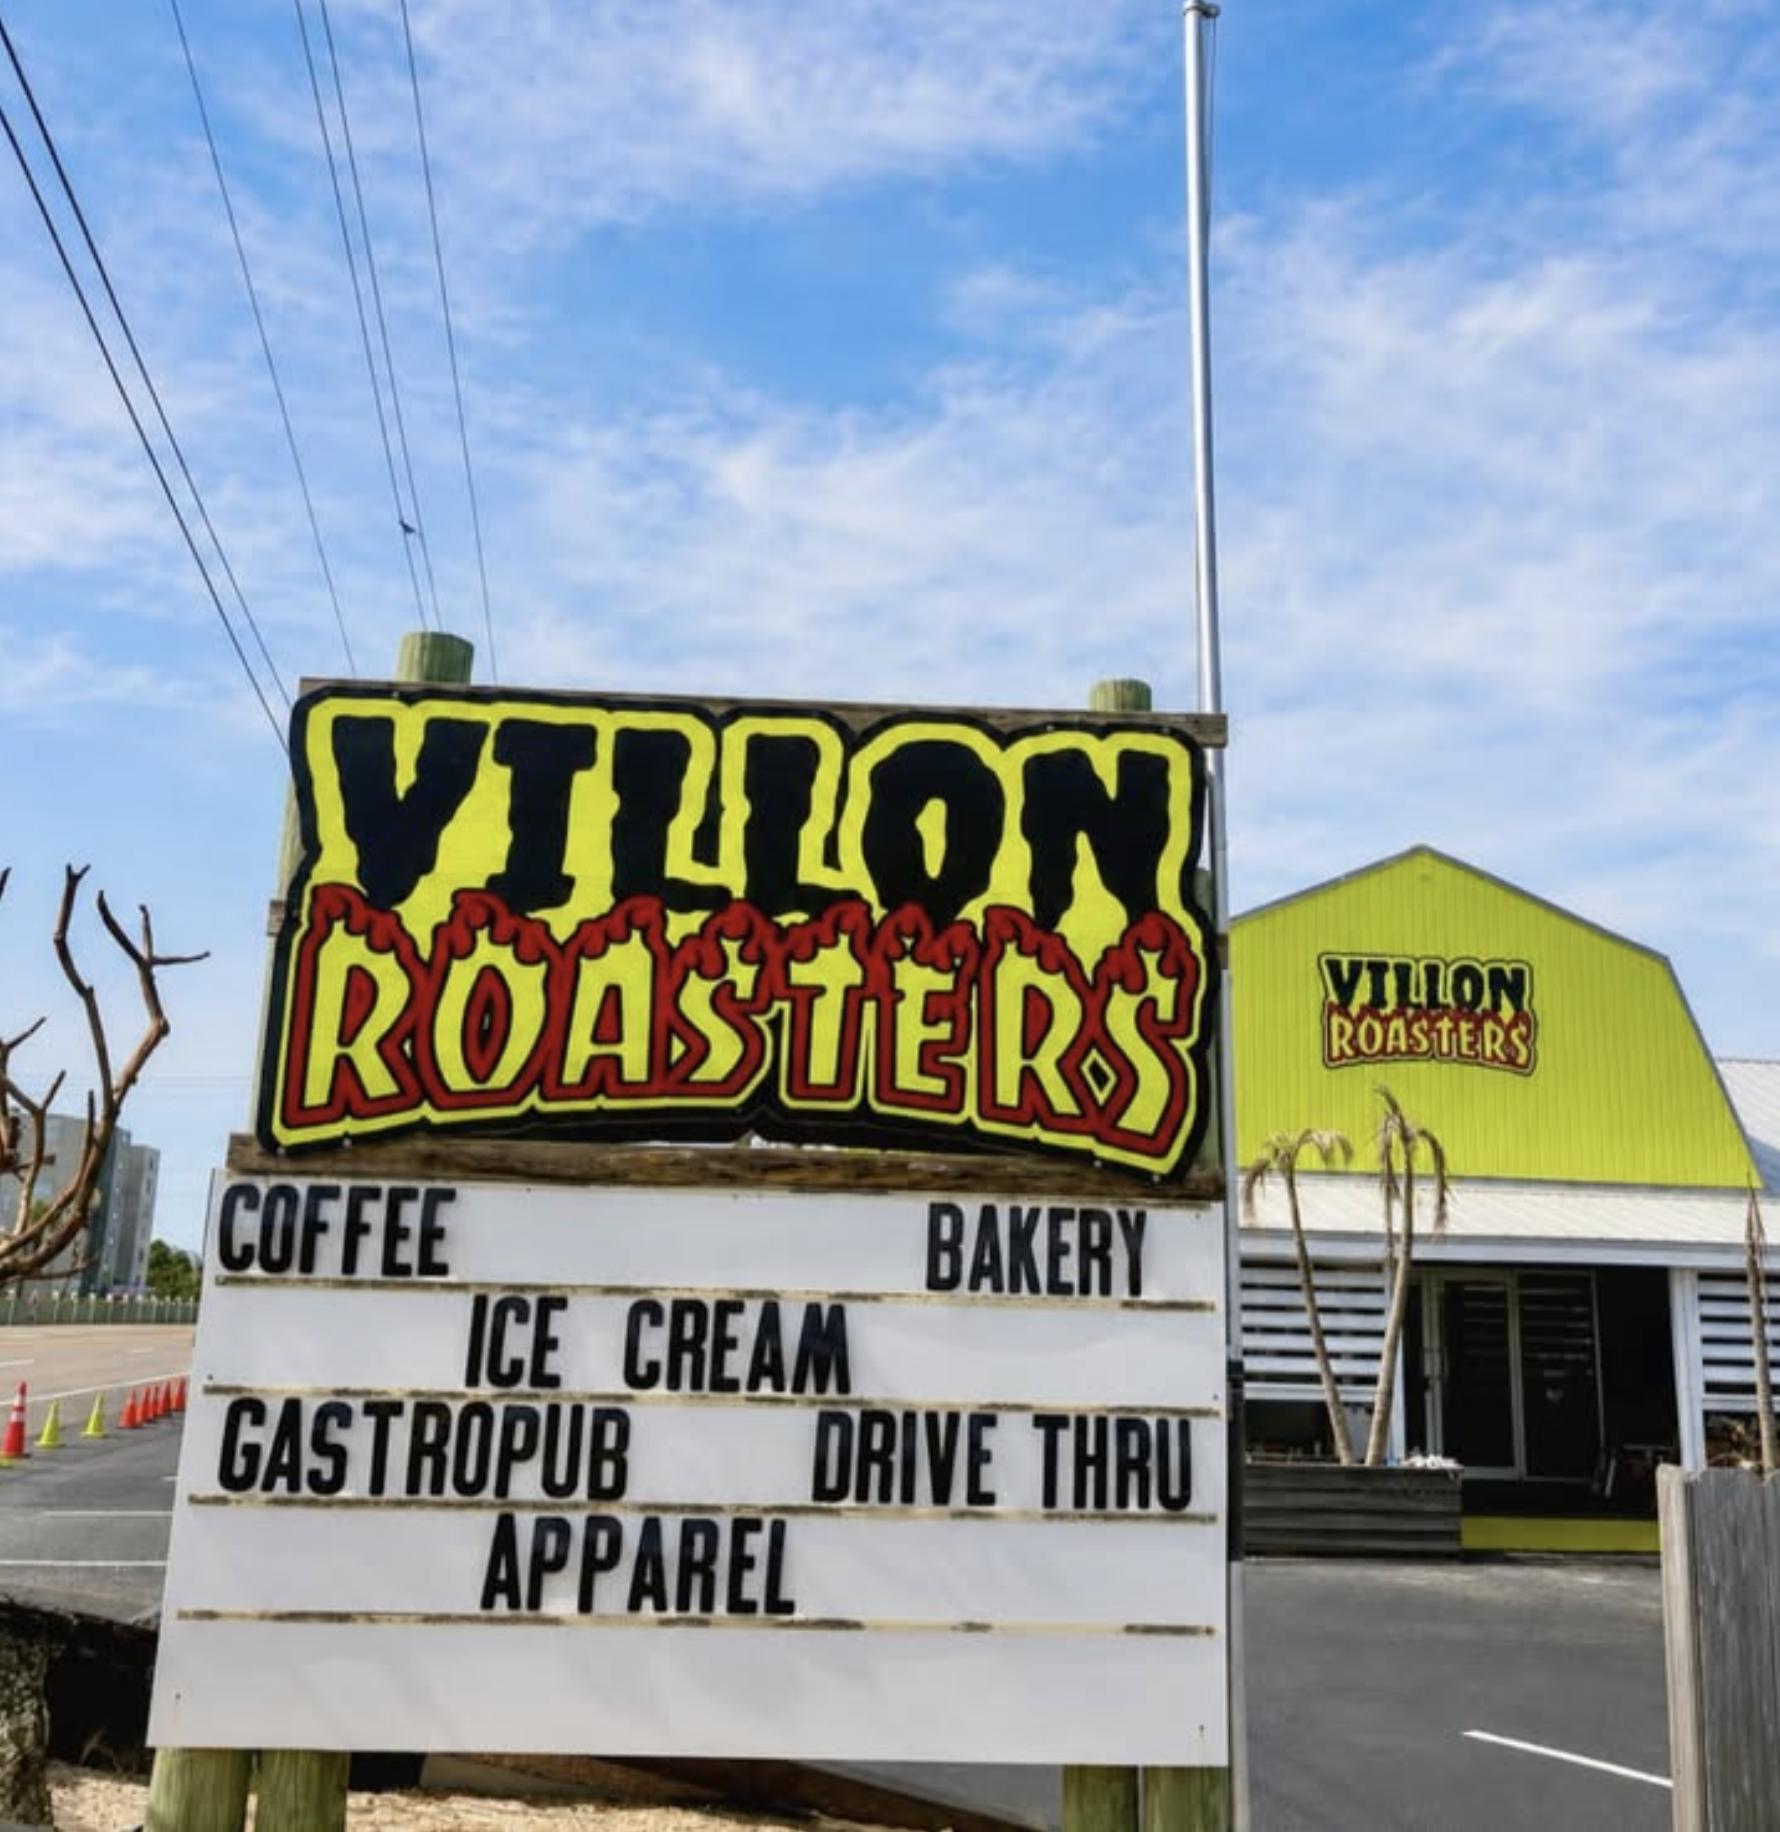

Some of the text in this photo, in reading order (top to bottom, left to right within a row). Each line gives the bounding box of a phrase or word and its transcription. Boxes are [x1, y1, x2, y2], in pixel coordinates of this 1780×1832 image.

[332, 714, 1170, 930] VILLON
[298, 908, 1183, 1140] ROASTERS
[1326, 958, 1526, 1012] VILLON
[1330, 1014, 1530, 1064] ROASTERS
[218, 1183, 1147, 1298] COFFEE BAKERY
[465, 1293, 851, 1396] ICE CREAM
[218, 1396, 1192, 1513] GASTROPUB DRIVE THRU
[480, 1511, 796, 1616] APPAREL
